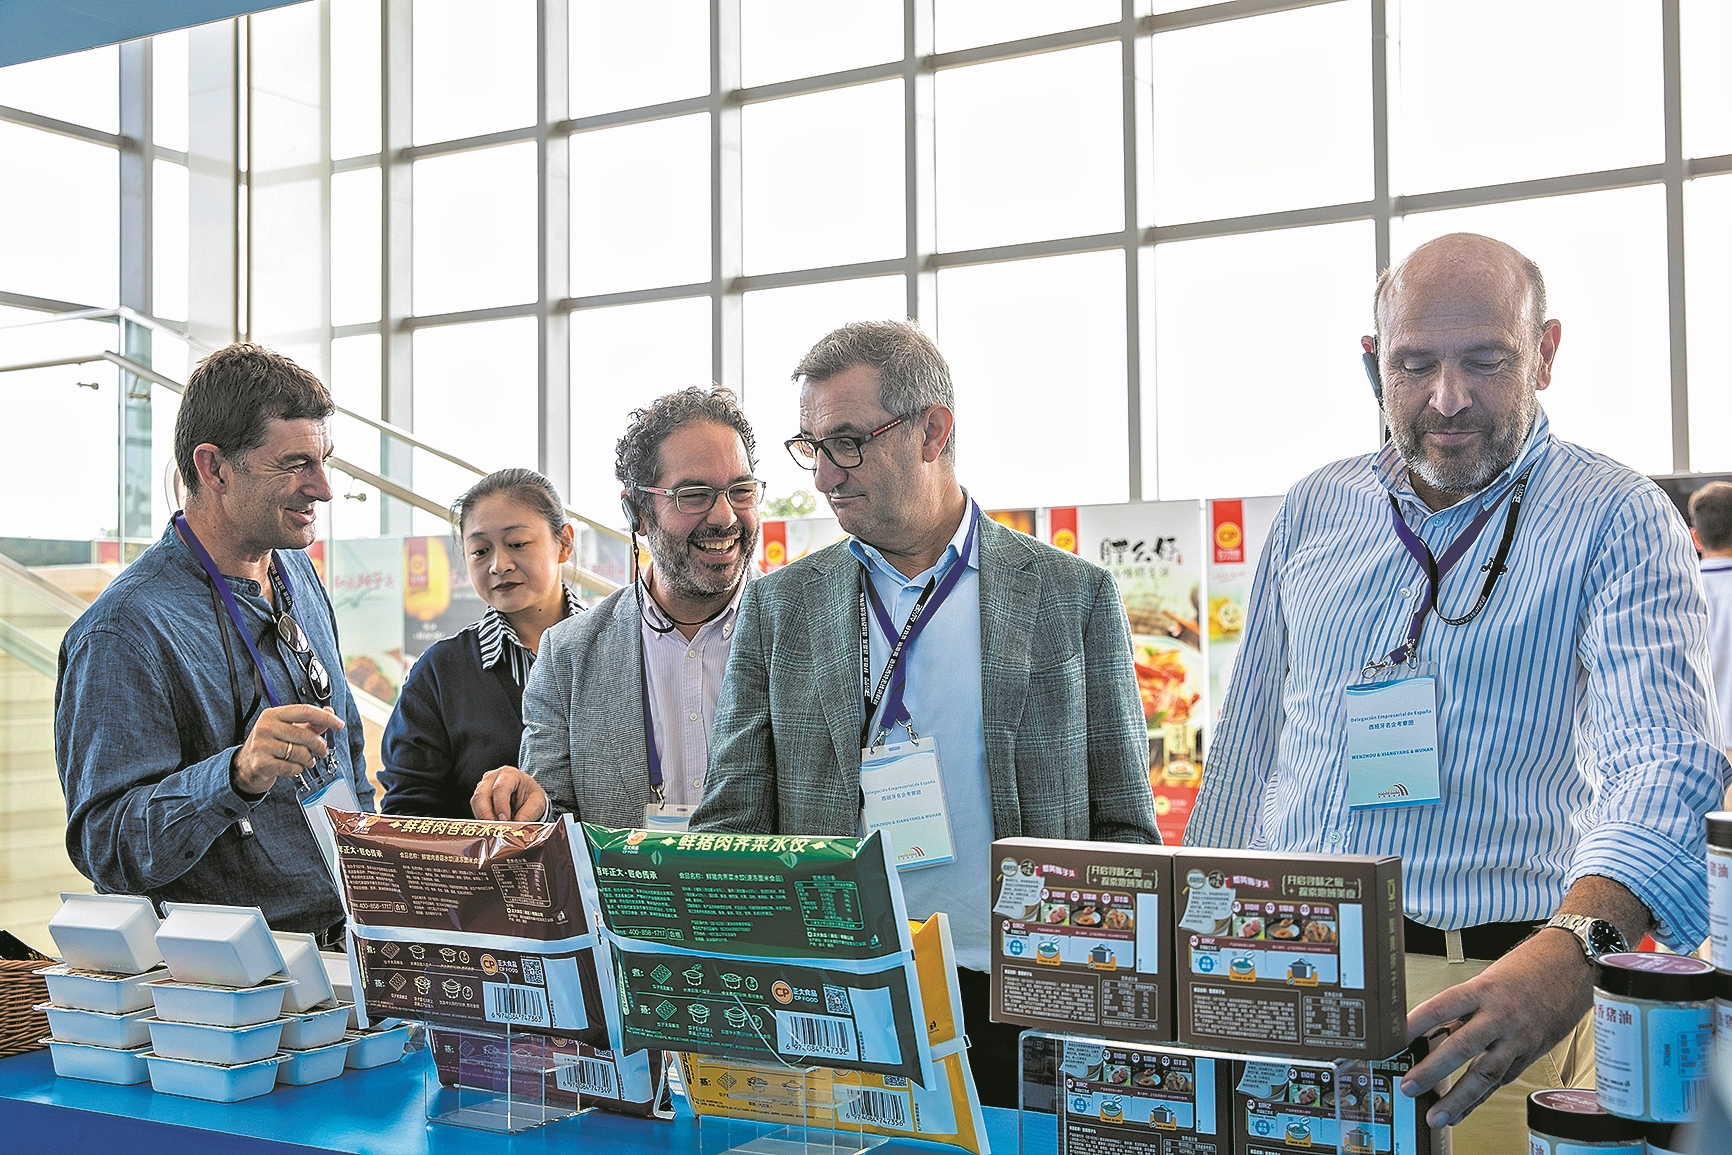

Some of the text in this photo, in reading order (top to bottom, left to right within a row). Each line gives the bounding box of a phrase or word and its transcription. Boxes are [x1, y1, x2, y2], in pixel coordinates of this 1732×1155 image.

[1378, 711, 1406, 720] Empresarial
[1414, 708, 1432, 716] España
[1368, 719, 1415, 730] 西班牙名企考察团
[1351, 751, 1377, 760] WENZHOU
[1381, 749, 1410, 757] XIANGYANG
[870, 820, 892, 828] WENZHOU
[896, 816, 921, 824] XIANGYANG
[401, 819, 512, 838] 鲜猪肉香菇水饺
[676, 834, 810, 853] 鲜猪肉荠菜水饺
[483, 960, 494, 969] CP
[775, 988, 789, 998] CP
[793, 988, 818, 997] 正大食品
[822, 1045, 848, 1055] 747332
